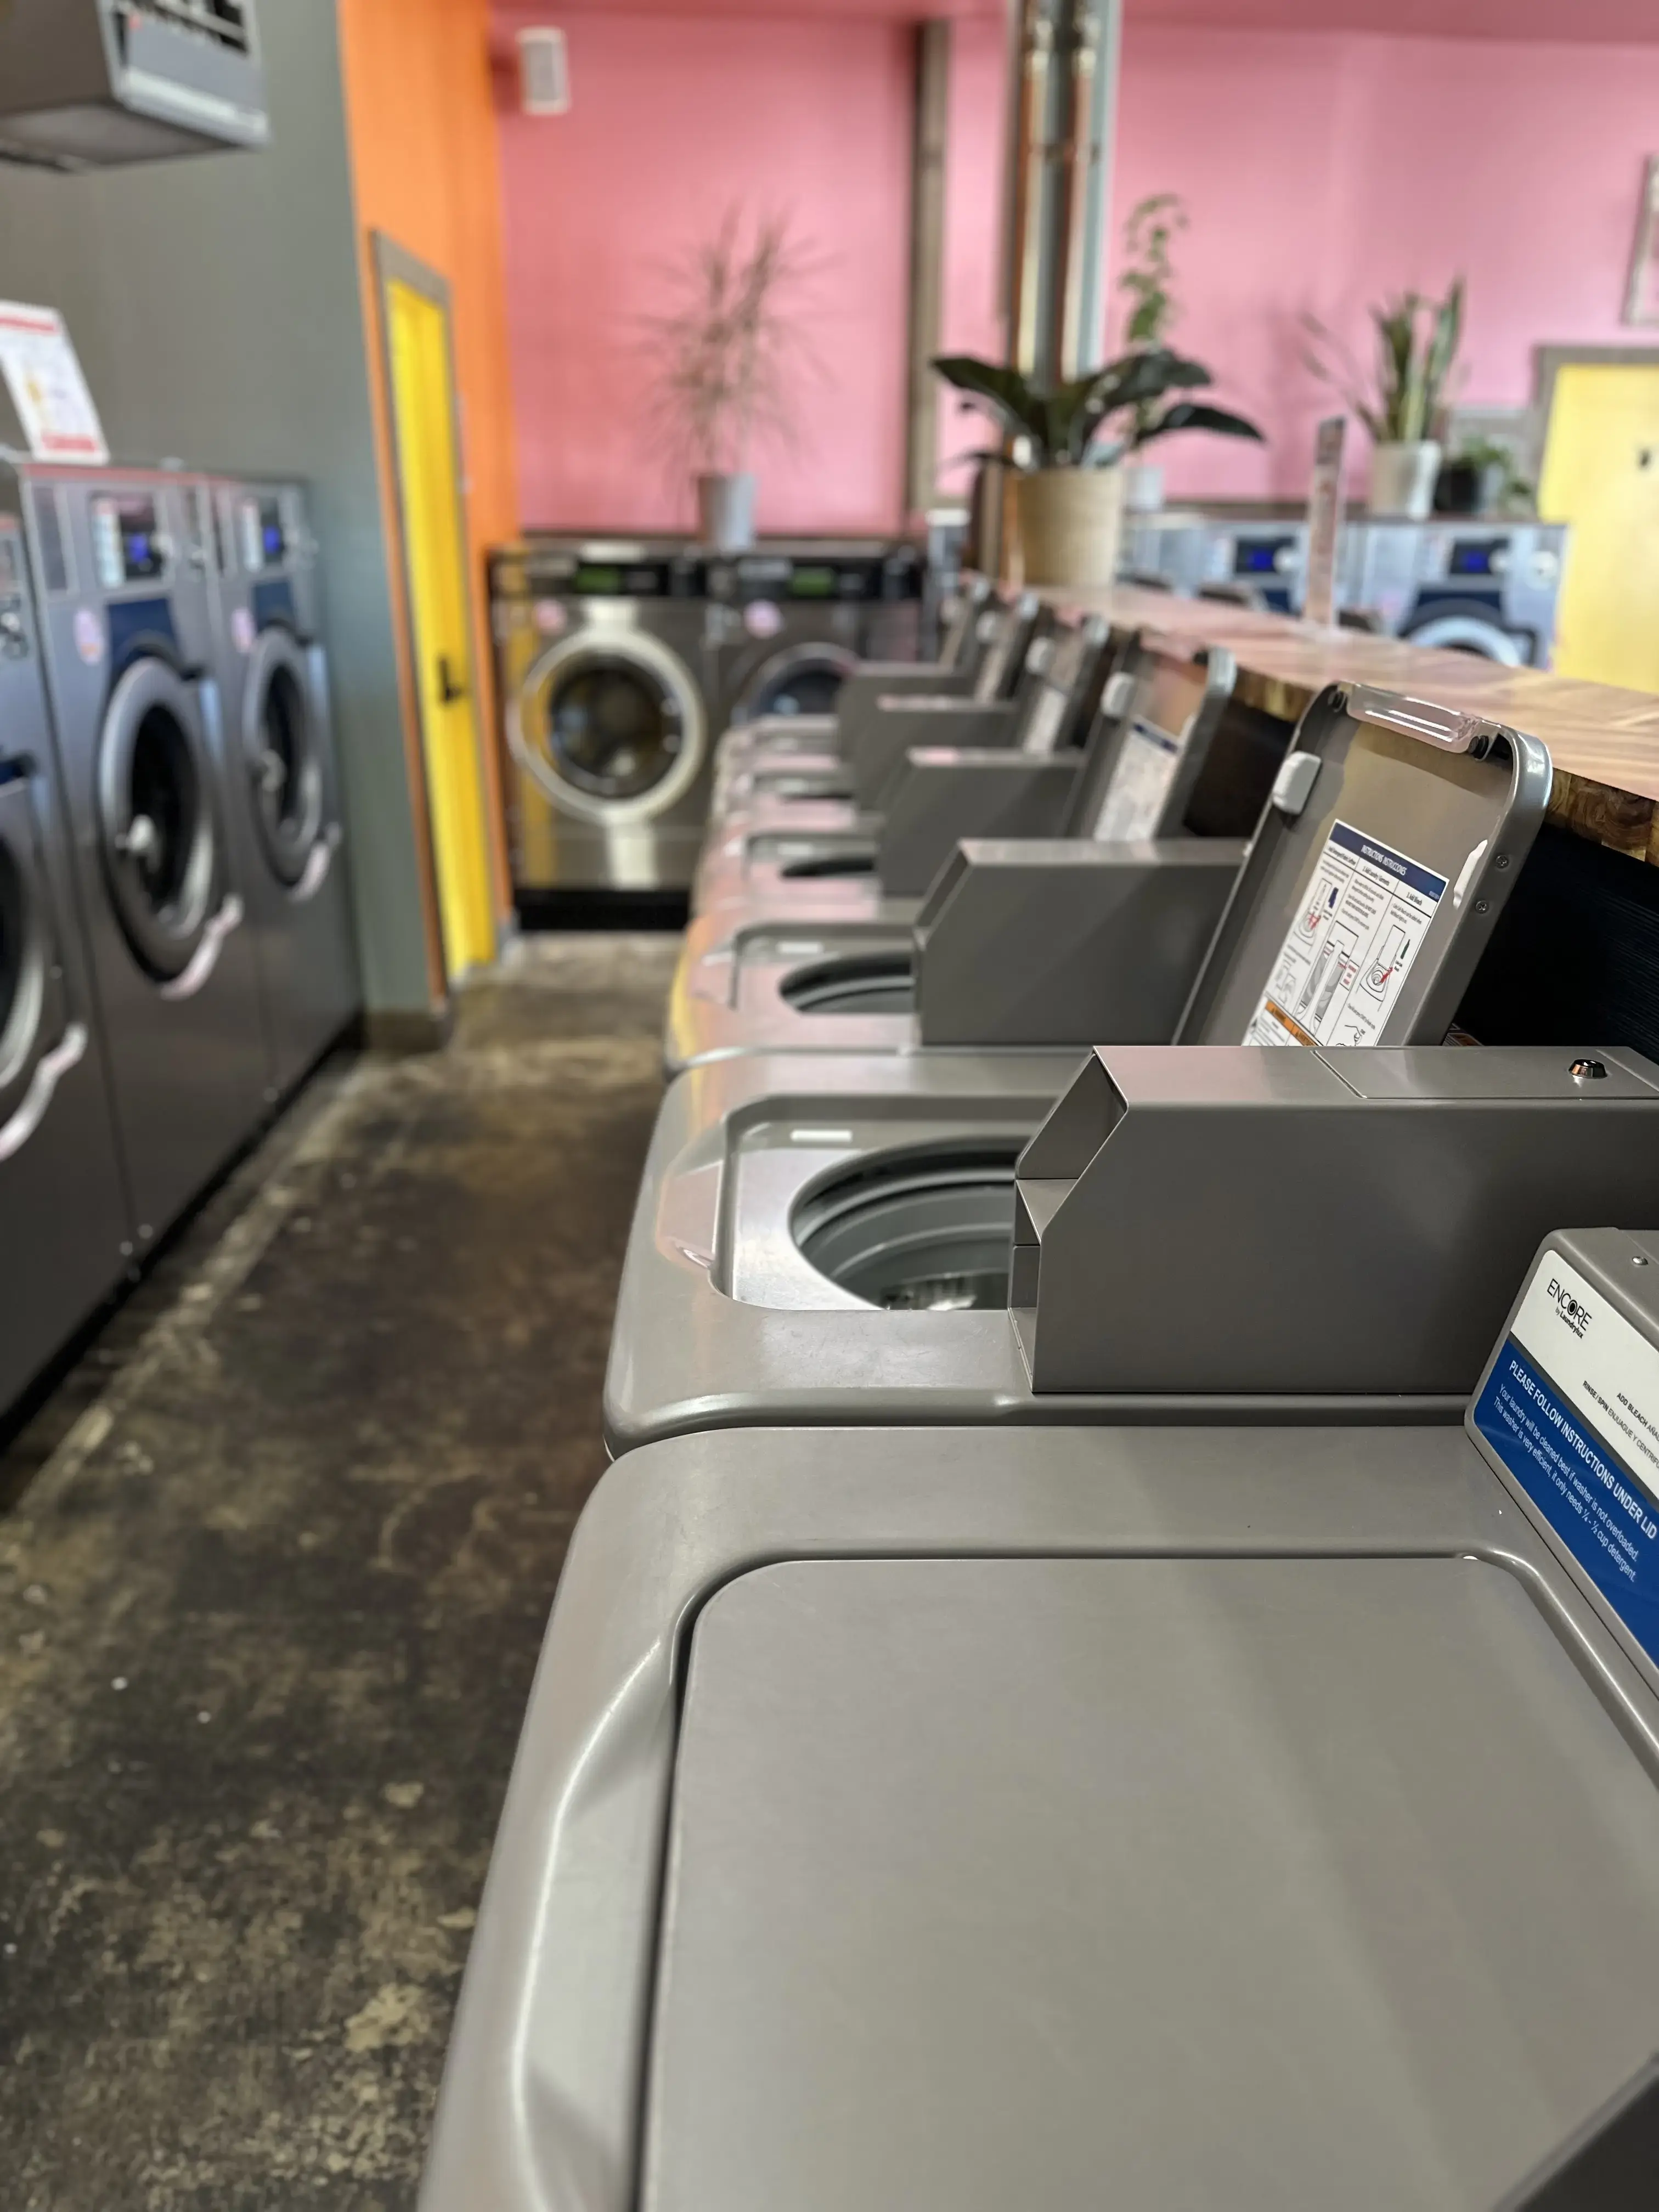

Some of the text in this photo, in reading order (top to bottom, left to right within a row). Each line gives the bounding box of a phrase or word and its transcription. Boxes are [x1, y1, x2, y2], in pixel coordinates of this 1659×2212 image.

[1361, 844, 1384, 863] INSTRUCTIONS
[1547, 1278, 1593, 1331] ENCORE
[1555, 1306, 1583, 1339] by Laundrylux
[1583, 1380, 1597, 1398] RINSE
[1598, 1397, 1609, 1412] SPIN
[1608, 1408, 1633, 1438] ENJUAGUE
[1633, 1434, 1637, 1442] Y
[1617, 1392, 1628, 1406] ADD
[1628, 1403, 1648, 1427] BLEACH
[1499, 1384, 1639, 1562] Your laundry will be cleaned best if washer is not overloaded.
[1509, 1360, 1657, 1540] PLEASE FOLLOW INSTRUCTIONS UNDER LID
[1493, 1396, 1504, 1414] This
[1502, 1409, 1520, 1433] washer
[1517, 1427, 1524, 1439] is
[1522, 1435, 1534, 1453] very
[1532, 1448, 1553, 1477] efficient,
[1551, 1470, 1558, 1482] it
[1555, 1477, 1568, 1496] only
[1566, 1490, 1583, 1514] needs
[1597, 1531, 1609, 1547] cup
[1607, 1543, 1637, 1582] detergent.
